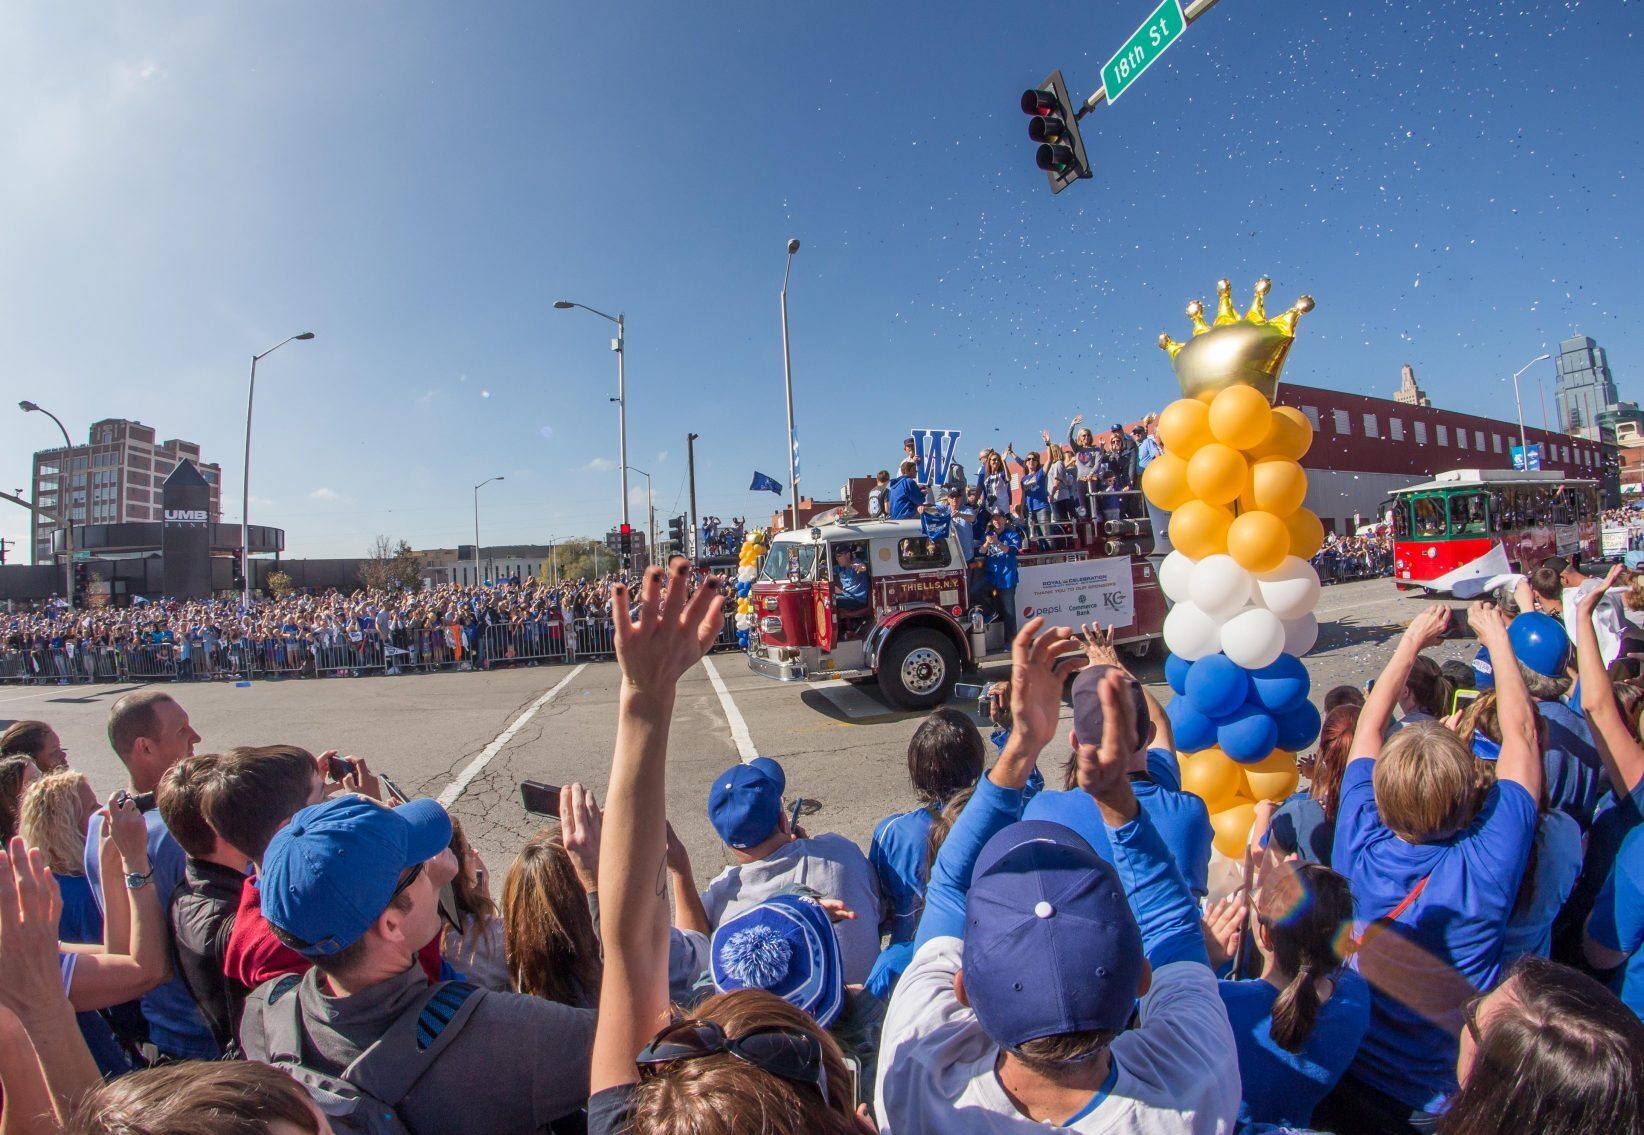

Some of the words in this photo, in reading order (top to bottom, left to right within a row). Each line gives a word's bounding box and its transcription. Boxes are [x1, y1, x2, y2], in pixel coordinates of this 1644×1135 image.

[1113, 46, 1145, 84] 18th
[1149, 17, 1170, 46] St
[911, 429, 961, 486] W
[165, 510, 208, 520] UMB
[1036, 604, 1062, 616] pepsi
[1069, 603, 1098, 612] Commerce
